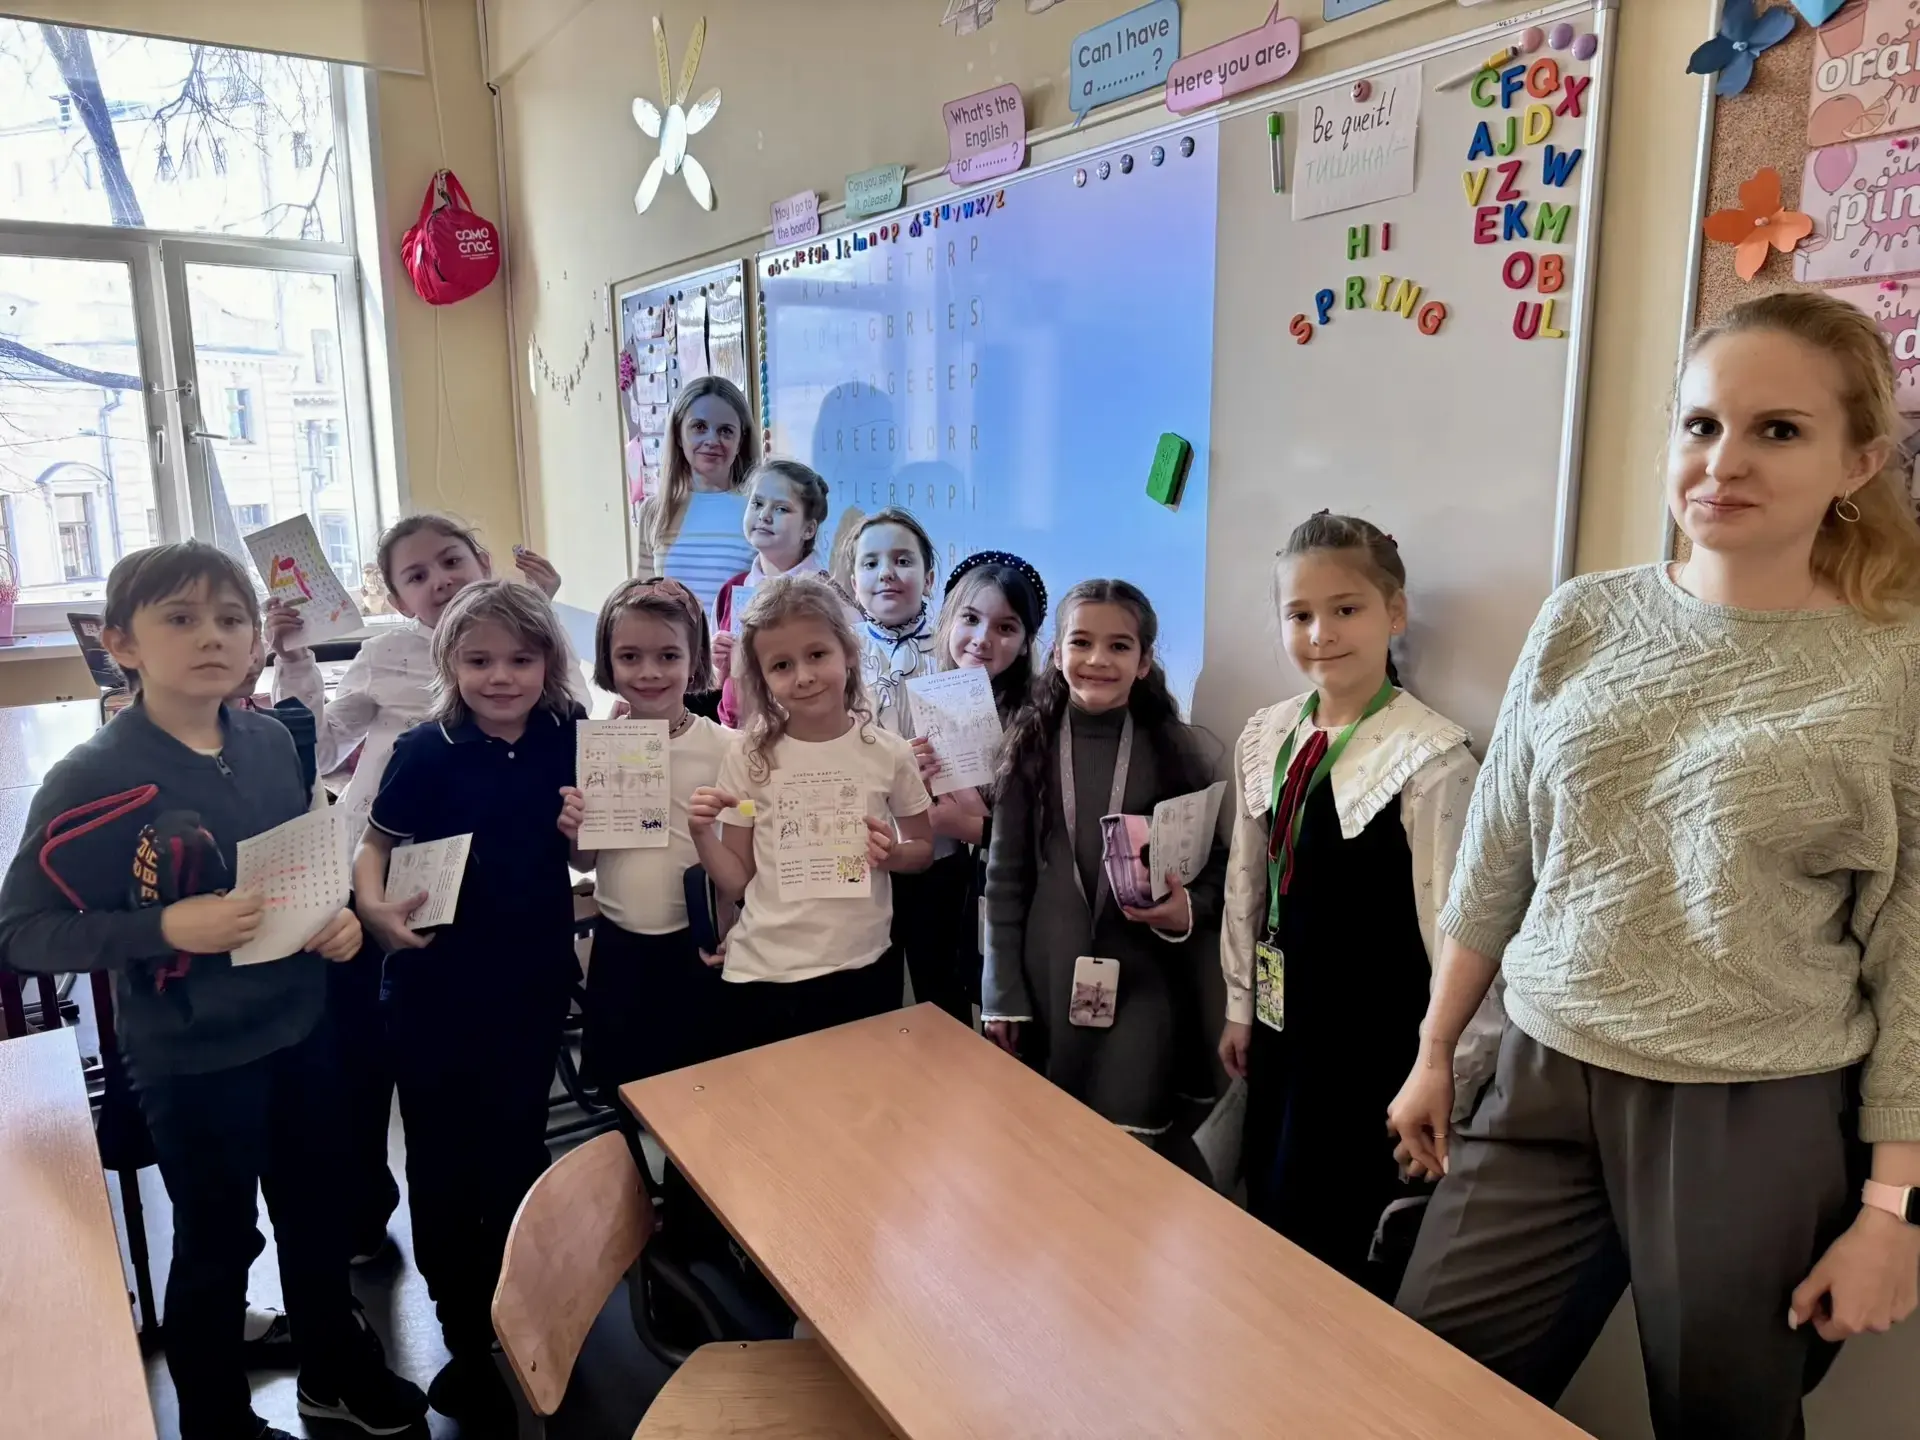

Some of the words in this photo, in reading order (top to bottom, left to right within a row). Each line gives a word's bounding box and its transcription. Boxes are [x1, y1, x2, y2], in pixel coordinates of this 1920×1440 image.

[1078, 42, 1112, 68] Can
[1117, 31, 1122, 55] I
[1125, 18, 1170, 51] have
[1174, 68, 1213, 96] Here
[1217, 54, 1250, 85] you
[1255, 41, 1292, 67] are.
[1816, 41, 1920, 92] ora
[1083, 79, 1094, 97] a
[950, 102, 993, 126] What's
[994, 95, 1017, 114] the
[1313, 105, 1334, 144] Be
[1341, 87, 1397, 152] queit!
[965, 121, 1009, 148] English
[957, 158, 973, 175] for
[775, 207, 790, 221] May
[777, 226, 790, 240] the
[790, 216, 815, 236] board?
